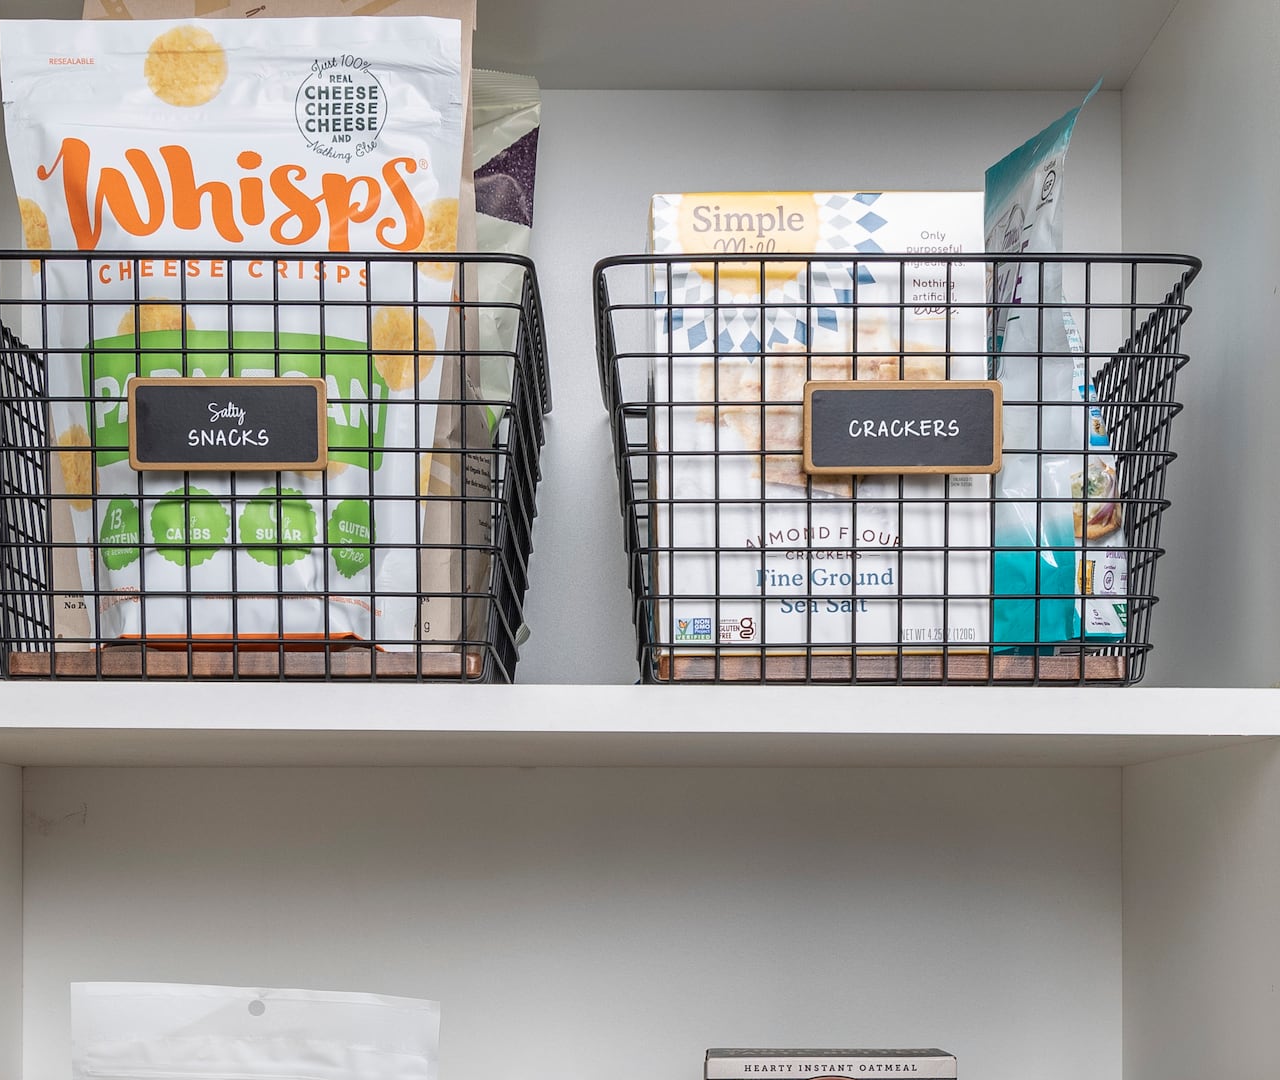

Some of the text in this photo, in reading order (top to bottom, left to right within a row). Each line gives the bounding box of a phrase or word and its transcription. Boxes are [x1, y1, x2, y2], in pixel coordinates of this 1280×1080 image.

[48, 57, 95, 65] RESEALABLE
[311, 54, 372, 79] Just 100%
[329, 74, 353, 83] REAL
[304, 85, 378, 100] CHEESE
[304, 102, 378, 116] CHEESE
[304, 117, 378, 133] CHEESE
[331, 134, 352, 143] AND
[306, 140, 378, 164] Nothing Else
[692, 205, 805, 238] Simple
[920, 230, 946, 242] Only
[99, 260, 225, 285] CHEESE
[912, 292, 957, 302] artificil,
[208, 401, 247, 426] Salty
[848, 419, 960, 438] CRACKERS
[188, 428, 270, 448] SNACKS
[166, 528, 211, 540] CABS
[755, 567, 895, 587] Fine Ground
[780, 599, 819, 614] Sea
[743, 1063, 919, 1072] HEARTY INSTANT OATMEAL
